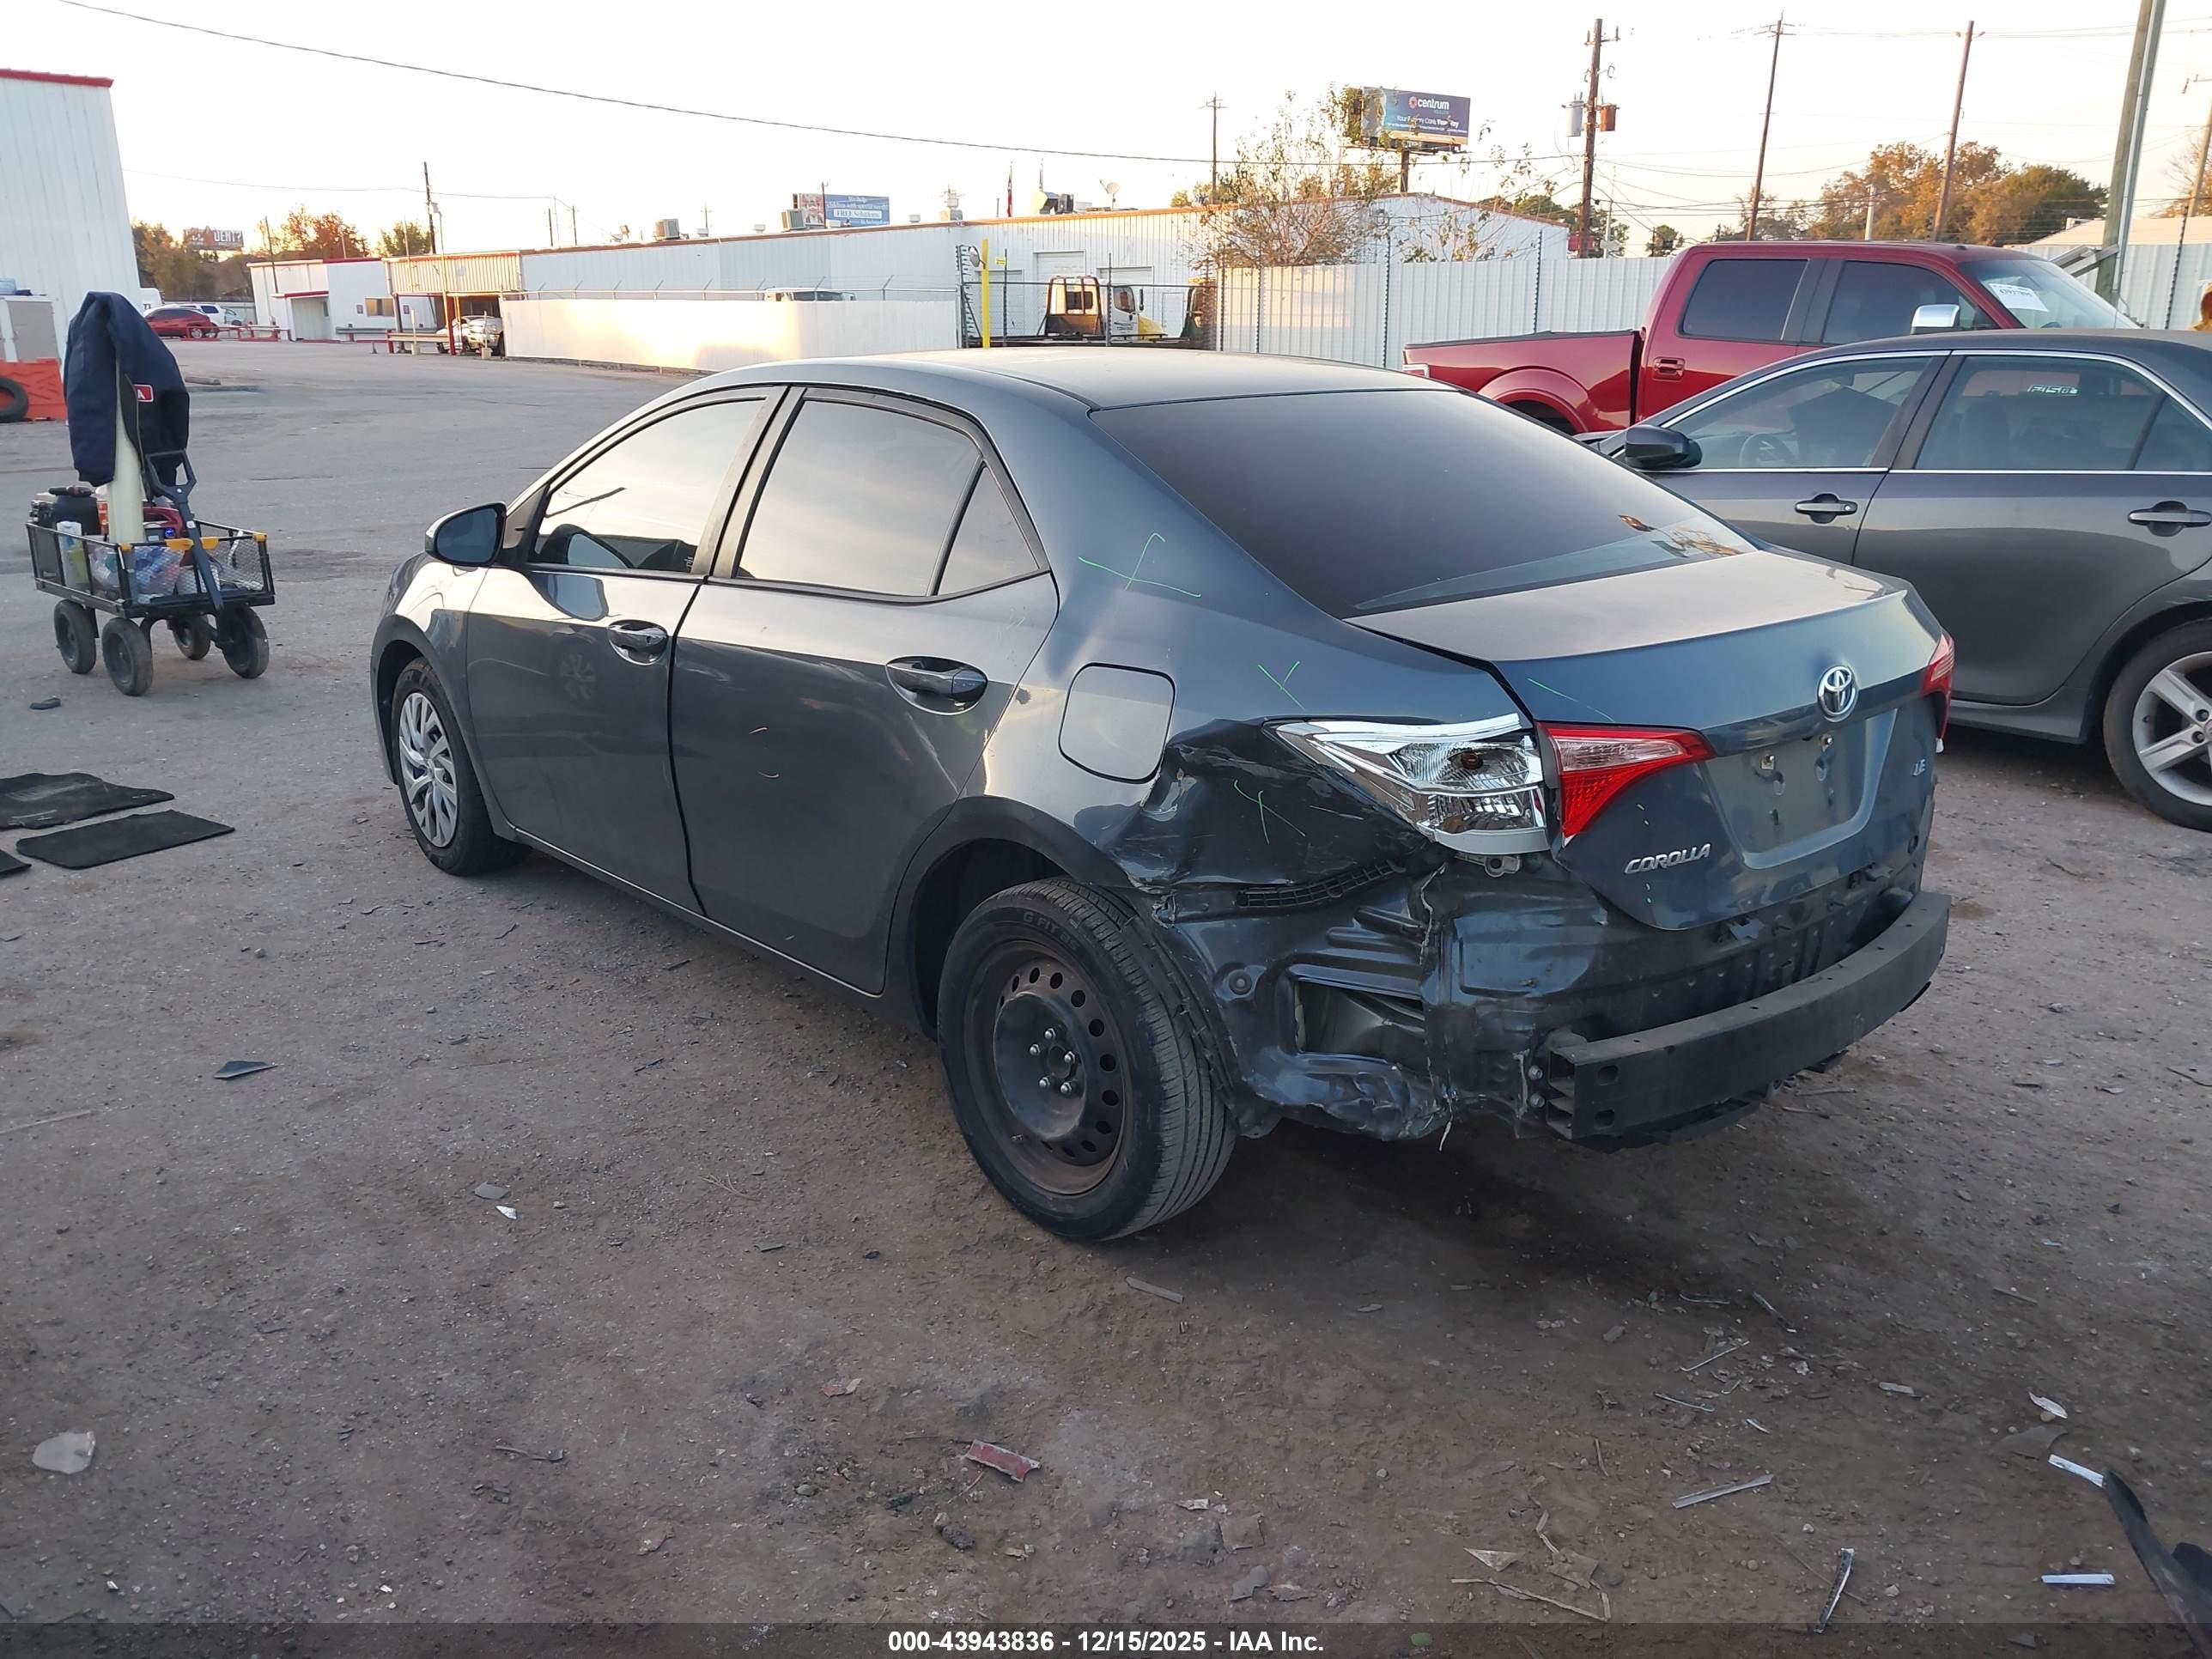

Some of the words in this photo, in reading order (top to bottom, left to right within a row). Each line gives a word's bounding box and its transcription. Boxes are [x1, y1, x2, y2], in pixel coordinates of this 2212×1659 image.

[1417, 98, 1449, 110] centrum
[1911, 759, 1926, 776] LE
[1625, 843, 1711, 874] COROLLA
